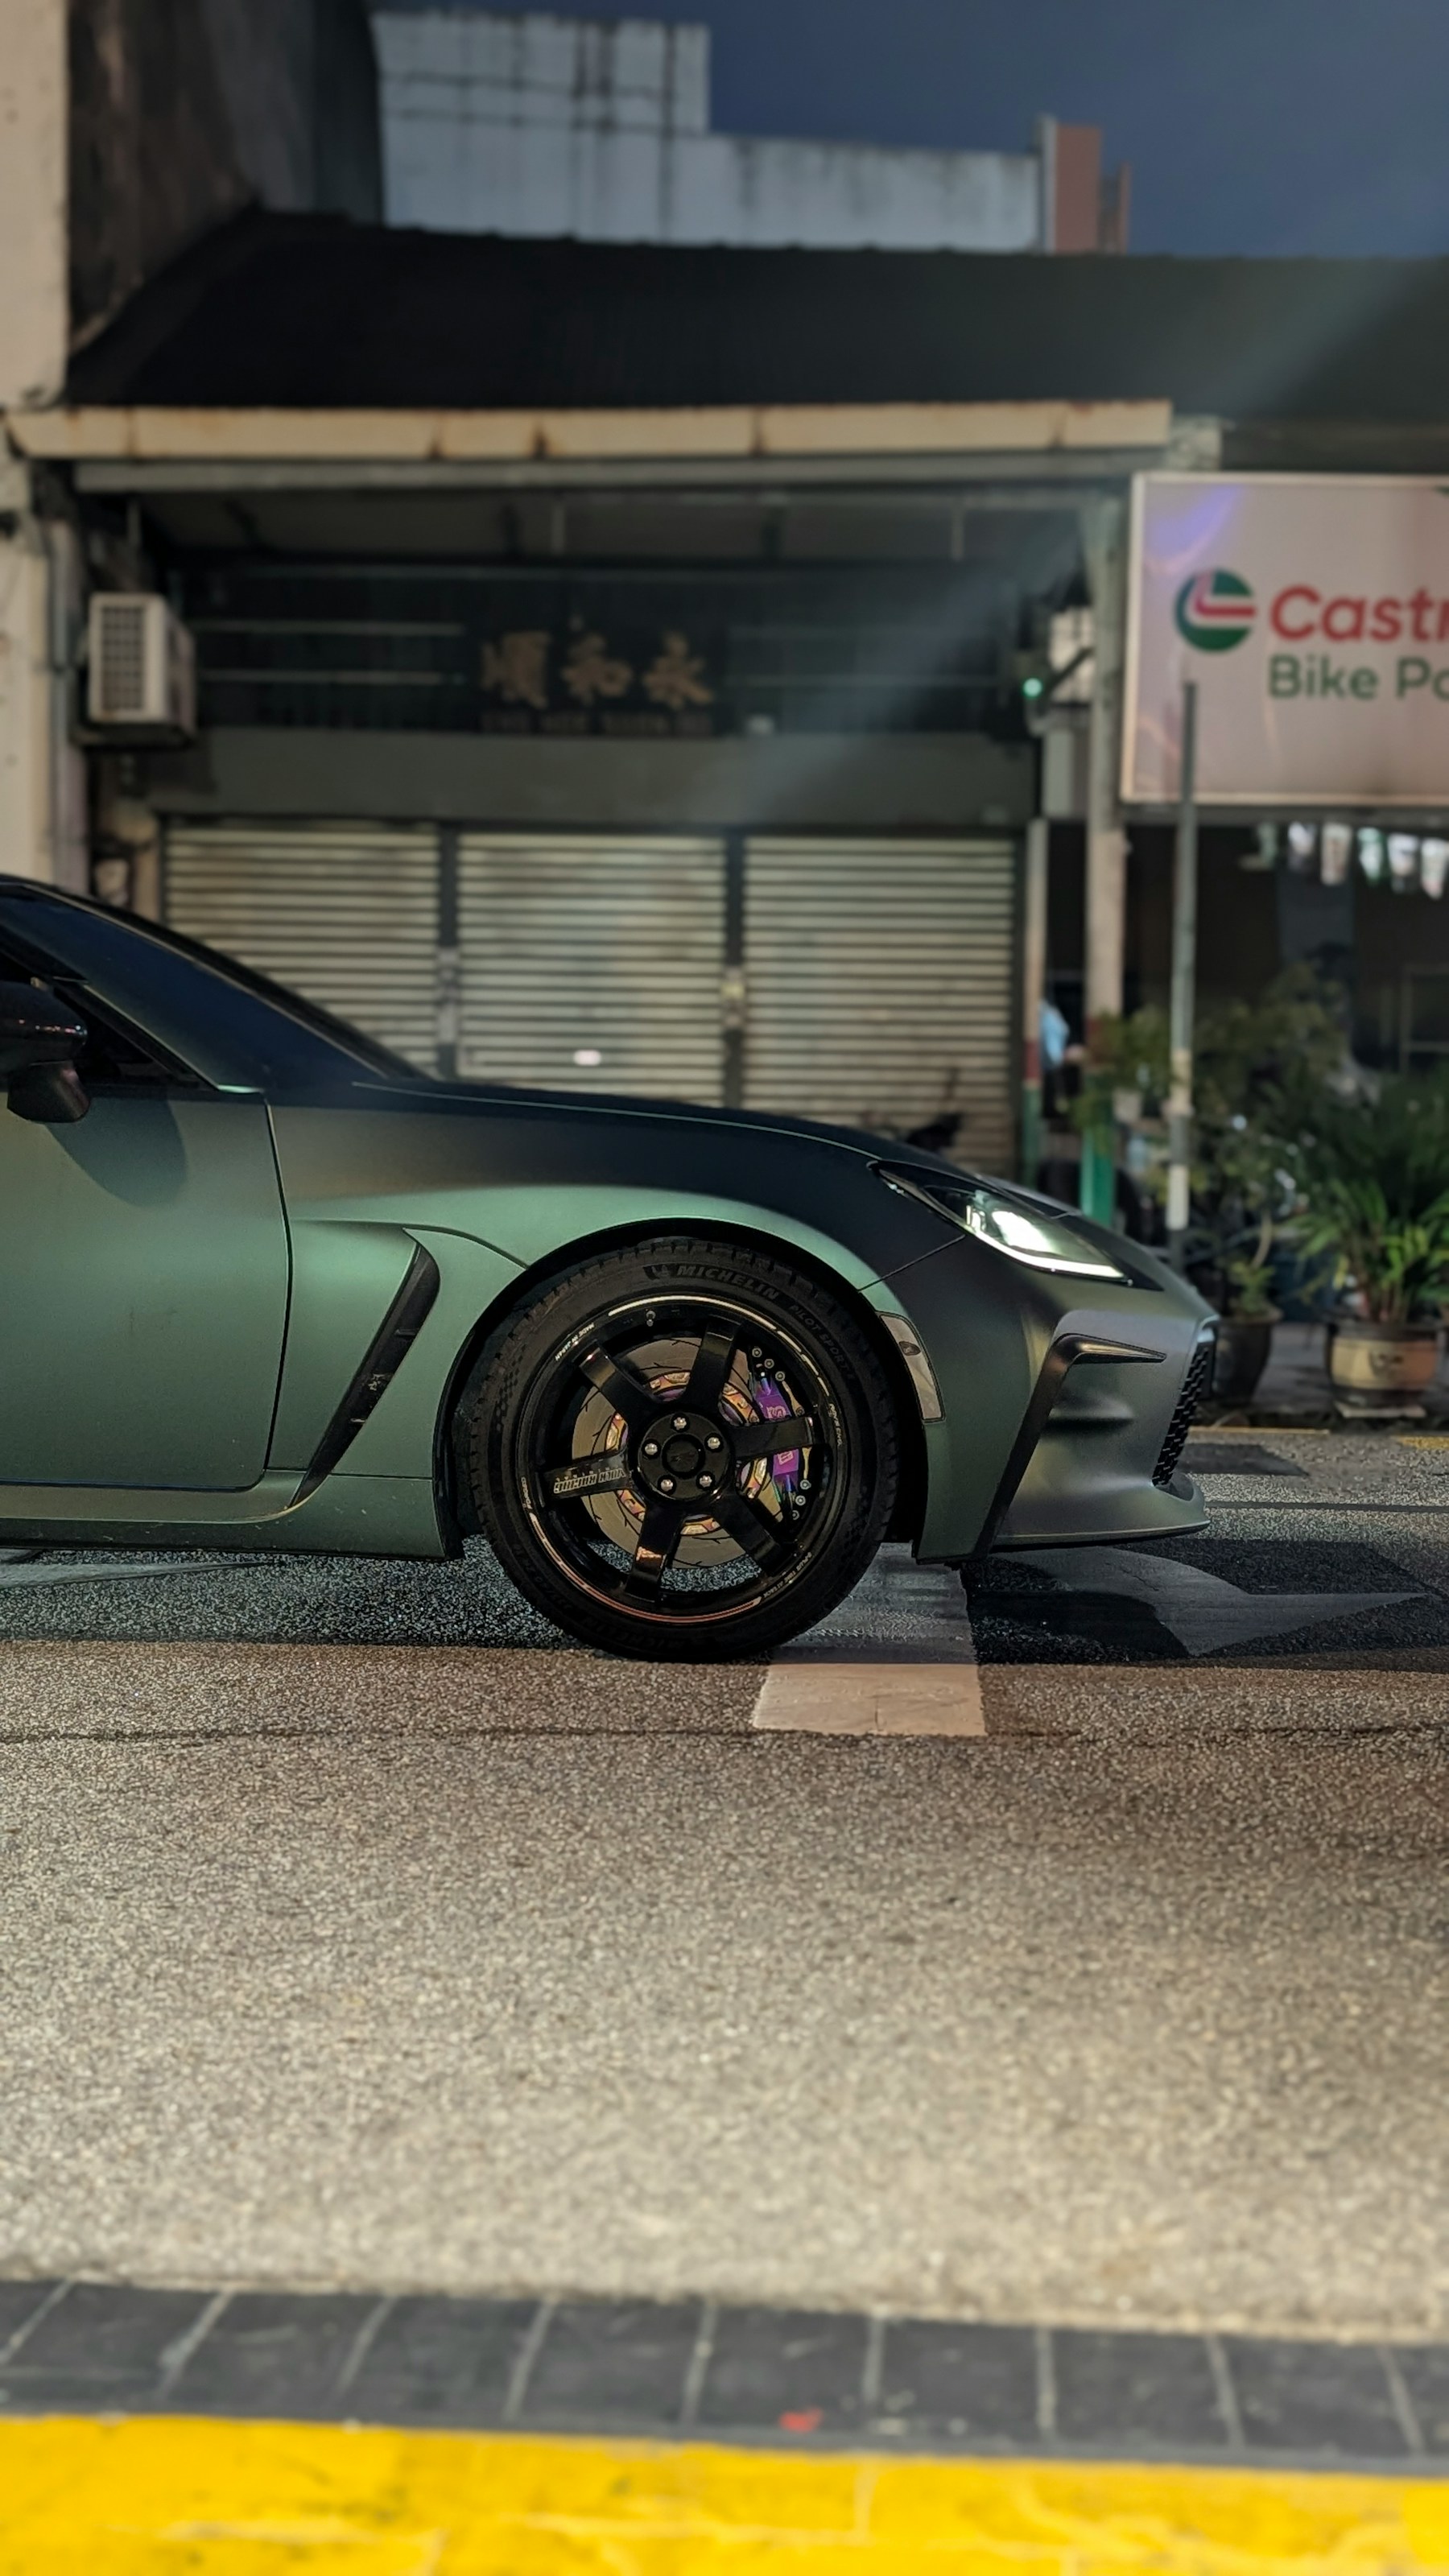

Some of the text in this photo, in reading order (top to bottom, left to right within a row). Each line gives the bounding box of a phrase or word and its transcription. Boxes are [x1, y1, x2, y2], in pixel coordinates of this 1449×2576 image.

[1269, 654, 1379, 699] Bike
[677, 1265, 779, 1299] MICHELIN
[789, 1304, 849, 1371] PILOT SPORT
[554, 1473, 597, 1494] RACING
